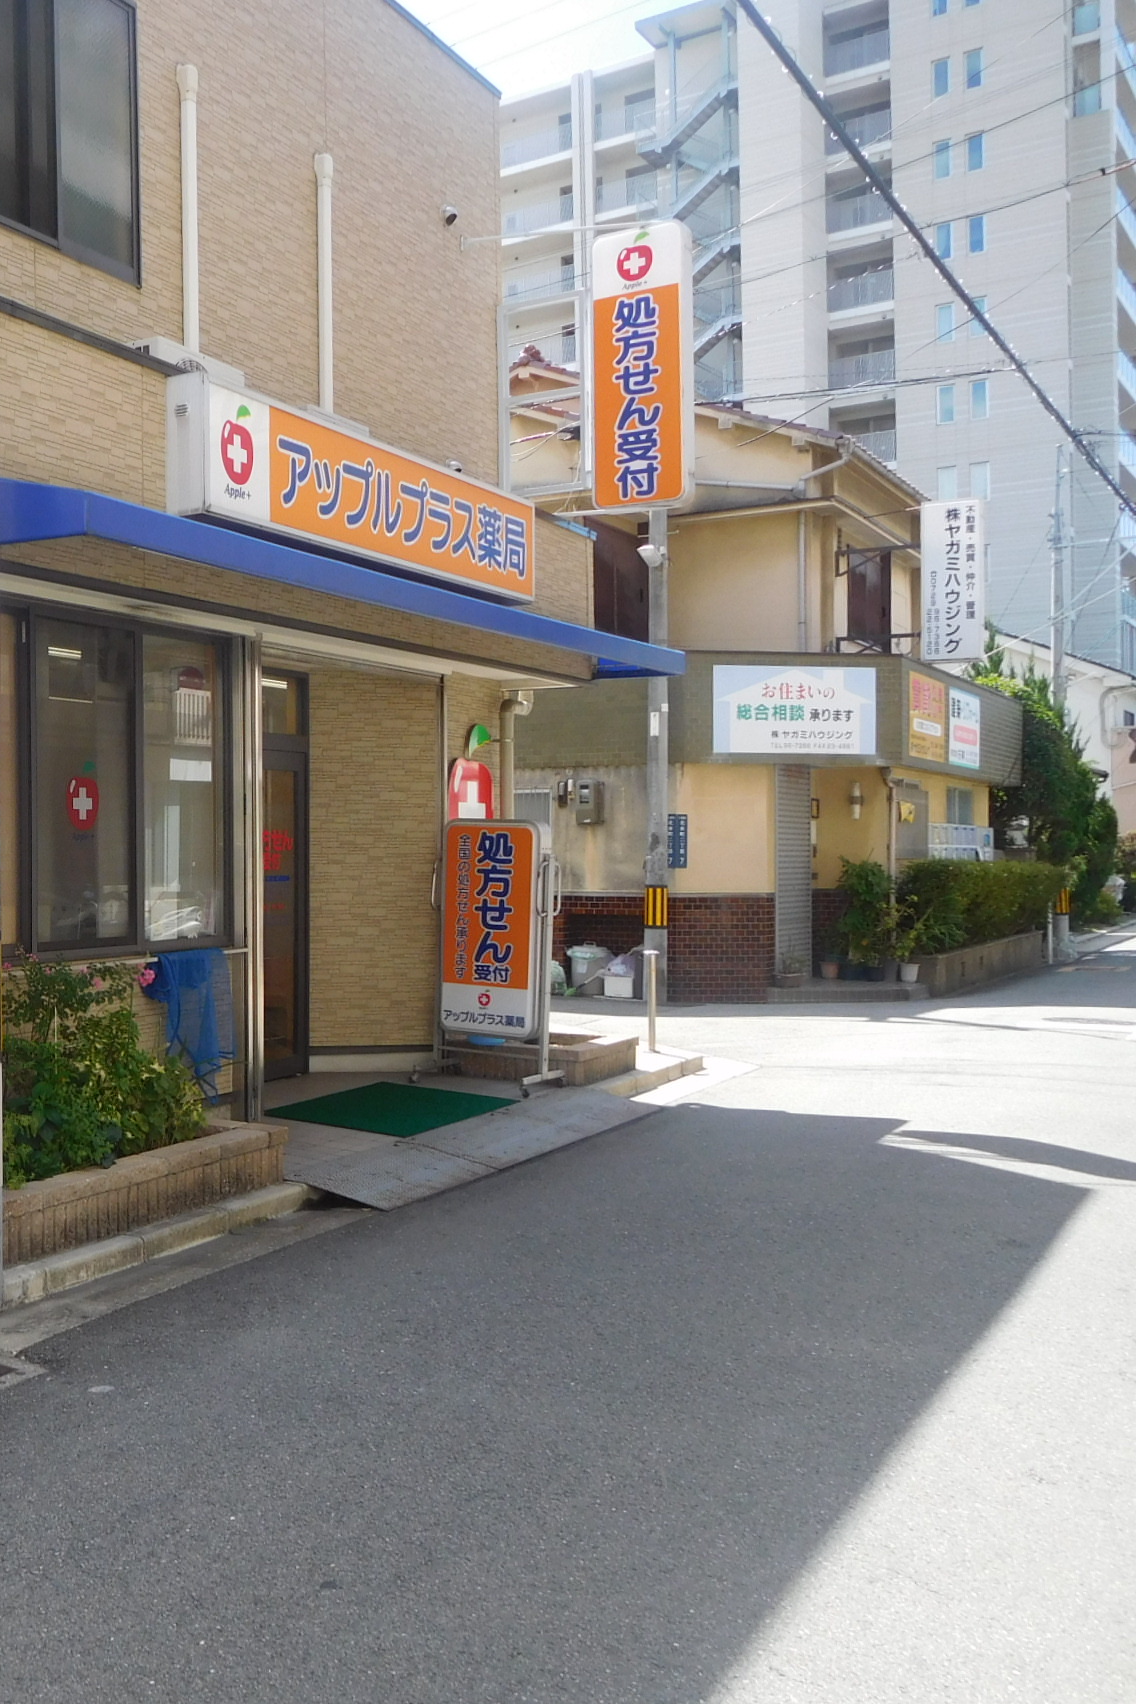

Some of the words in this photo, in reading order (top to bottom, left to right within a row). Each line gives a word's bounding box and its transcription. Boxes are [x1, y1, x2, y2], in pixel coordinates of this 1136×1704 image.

[614, 295, 660, 498] 処方せん受付
[276, 435, 527, 580] アップルプラス薬局
[761, 682, 836, 700] お住まいの
[736, 703, 805, 722] 総合相談
[809, 708, 854, 723] 承ります
[782, 730, 853, 740] ヤガミハウジング
[474, 831, 514, 964] 処方せん
[473, 964, 511, 983] 受付
[443, 1009, 526, 1029] アップルプラス薬局
